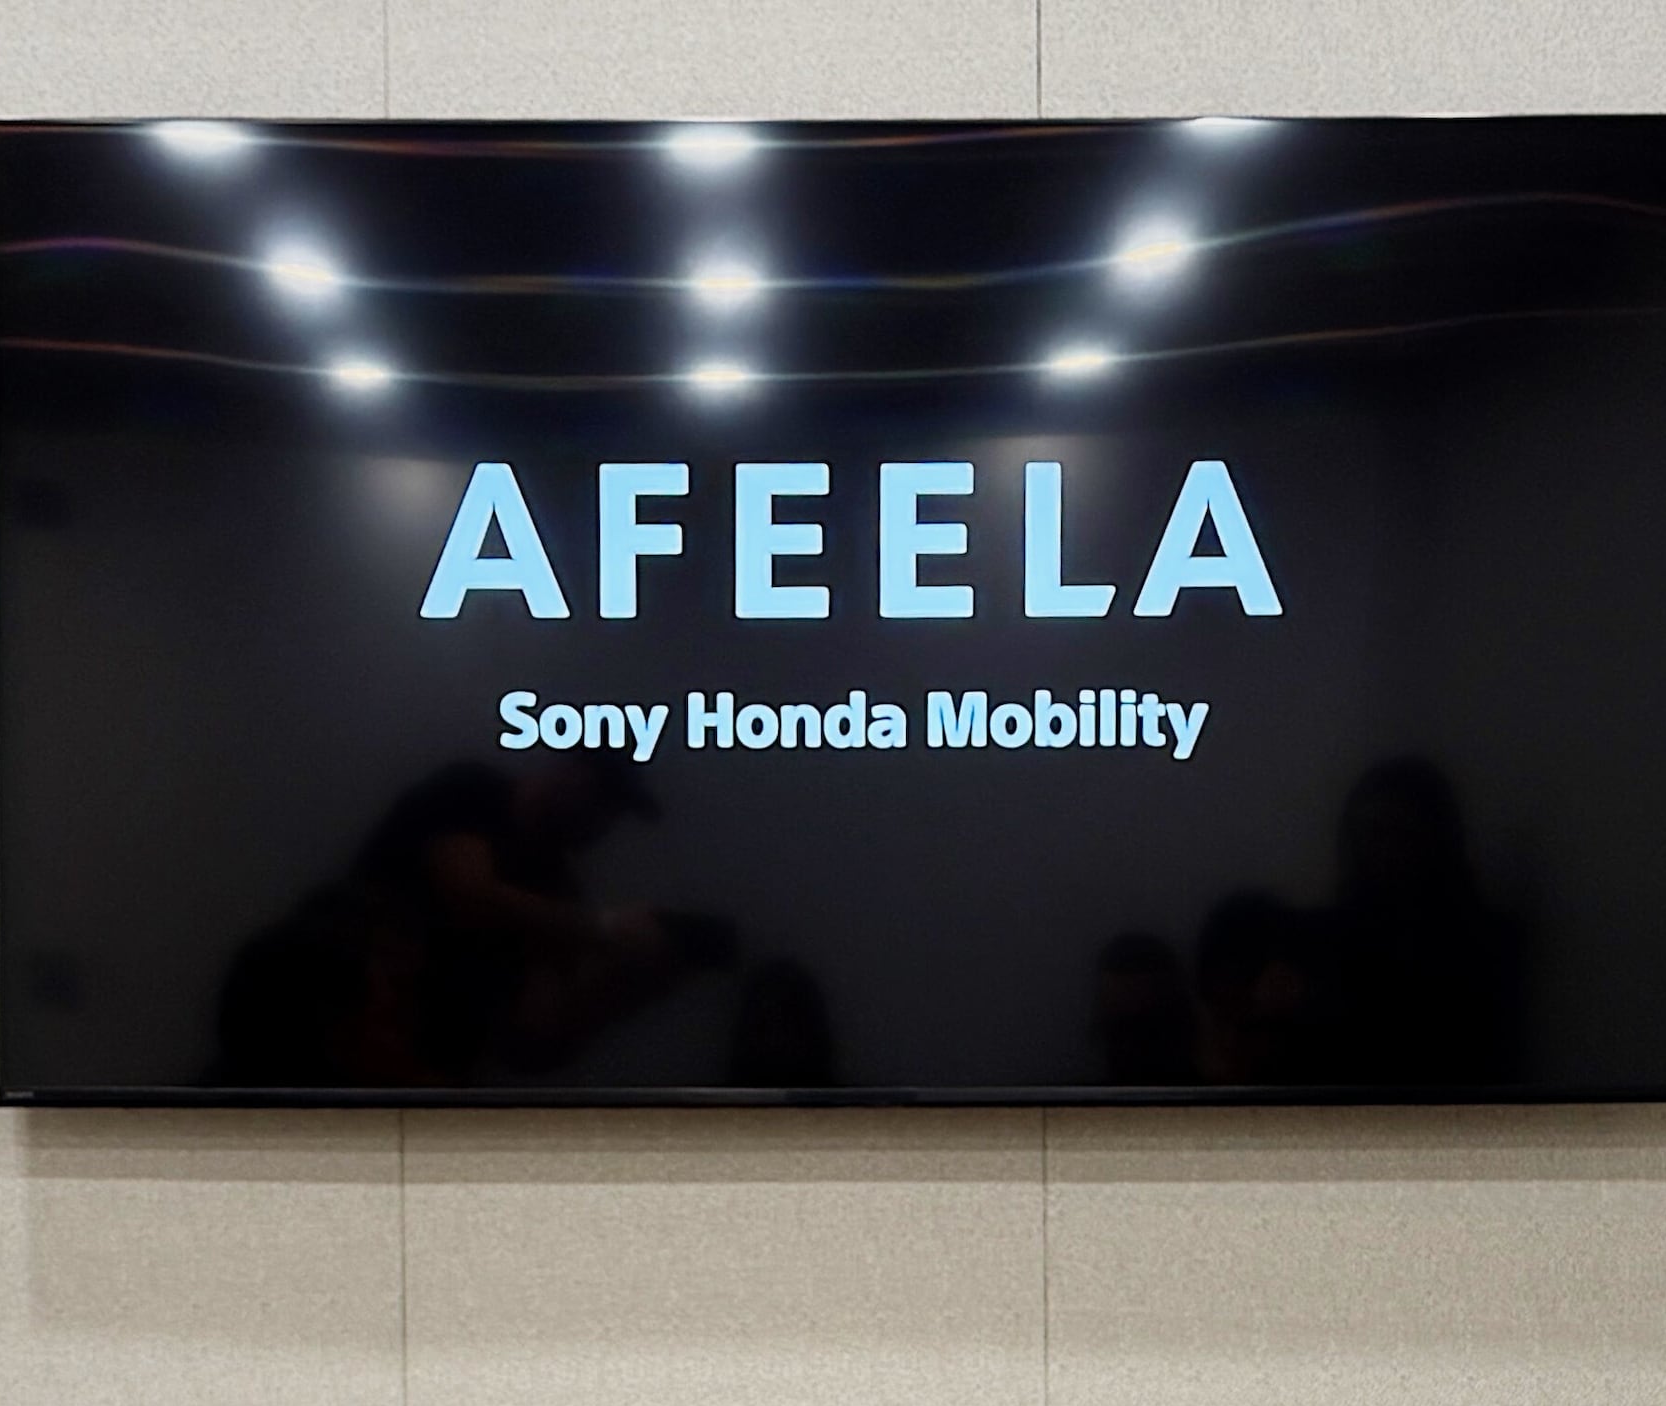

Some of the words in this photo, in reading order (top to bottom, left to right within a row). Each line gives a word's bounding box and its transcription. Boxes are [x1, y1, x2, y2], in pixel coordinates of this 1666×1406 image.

[419, 459, 1284, 619] AFEELA
[499, 691, 668, 761] Sony
[688, 691, 907, 749] Honda
[927, 689, 1209, 760] Mobility
